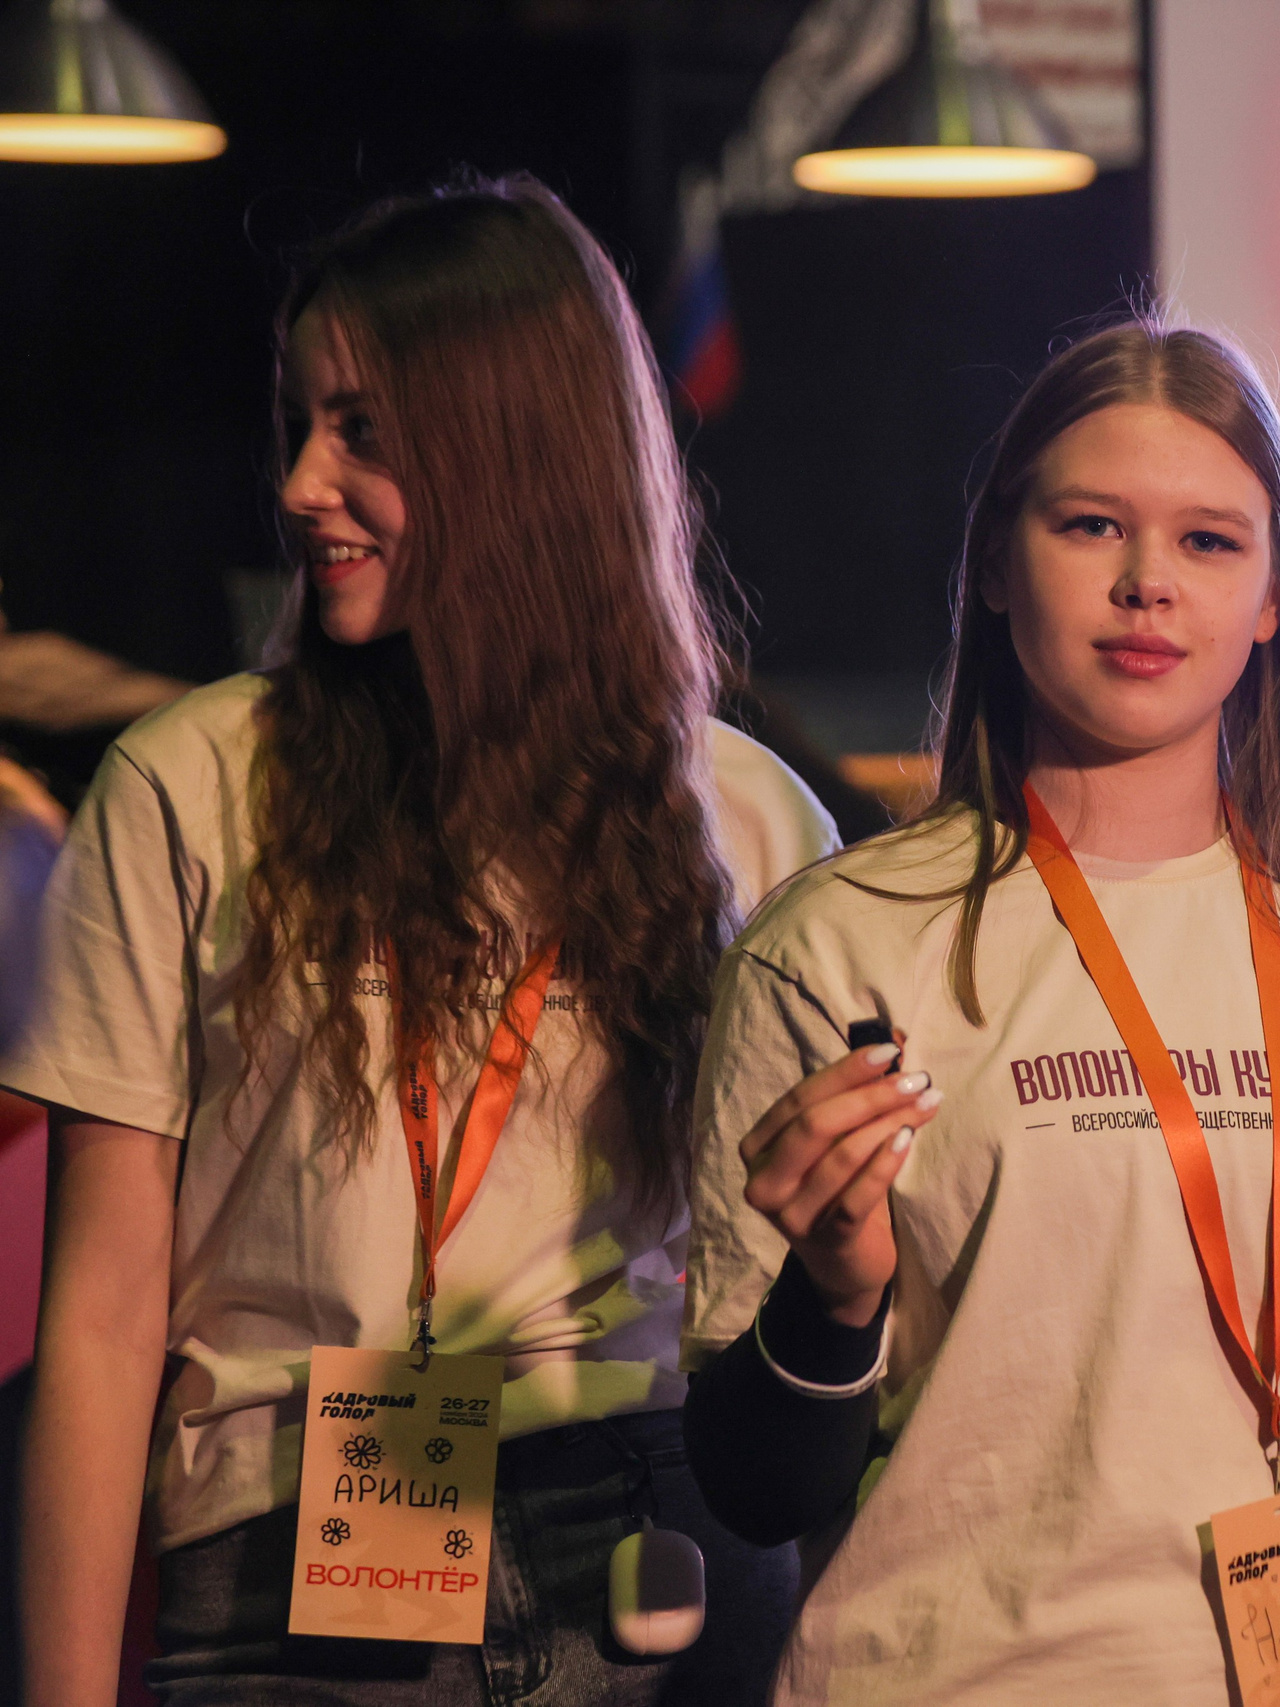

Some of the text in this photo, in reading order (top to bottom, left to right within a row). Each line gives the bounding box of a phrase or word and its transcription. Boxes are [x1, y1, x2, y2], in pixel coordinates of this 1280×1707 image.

[1010, 1048, 1222, 1106] ВОЛОНТРЫ
[1071, 1108, 1161, 1133] ВСЕРОССИЙС
[334, 1473, 460, 1513] АРИША
[305, 1563, 480, 1593] ВОЛОНТЁР
